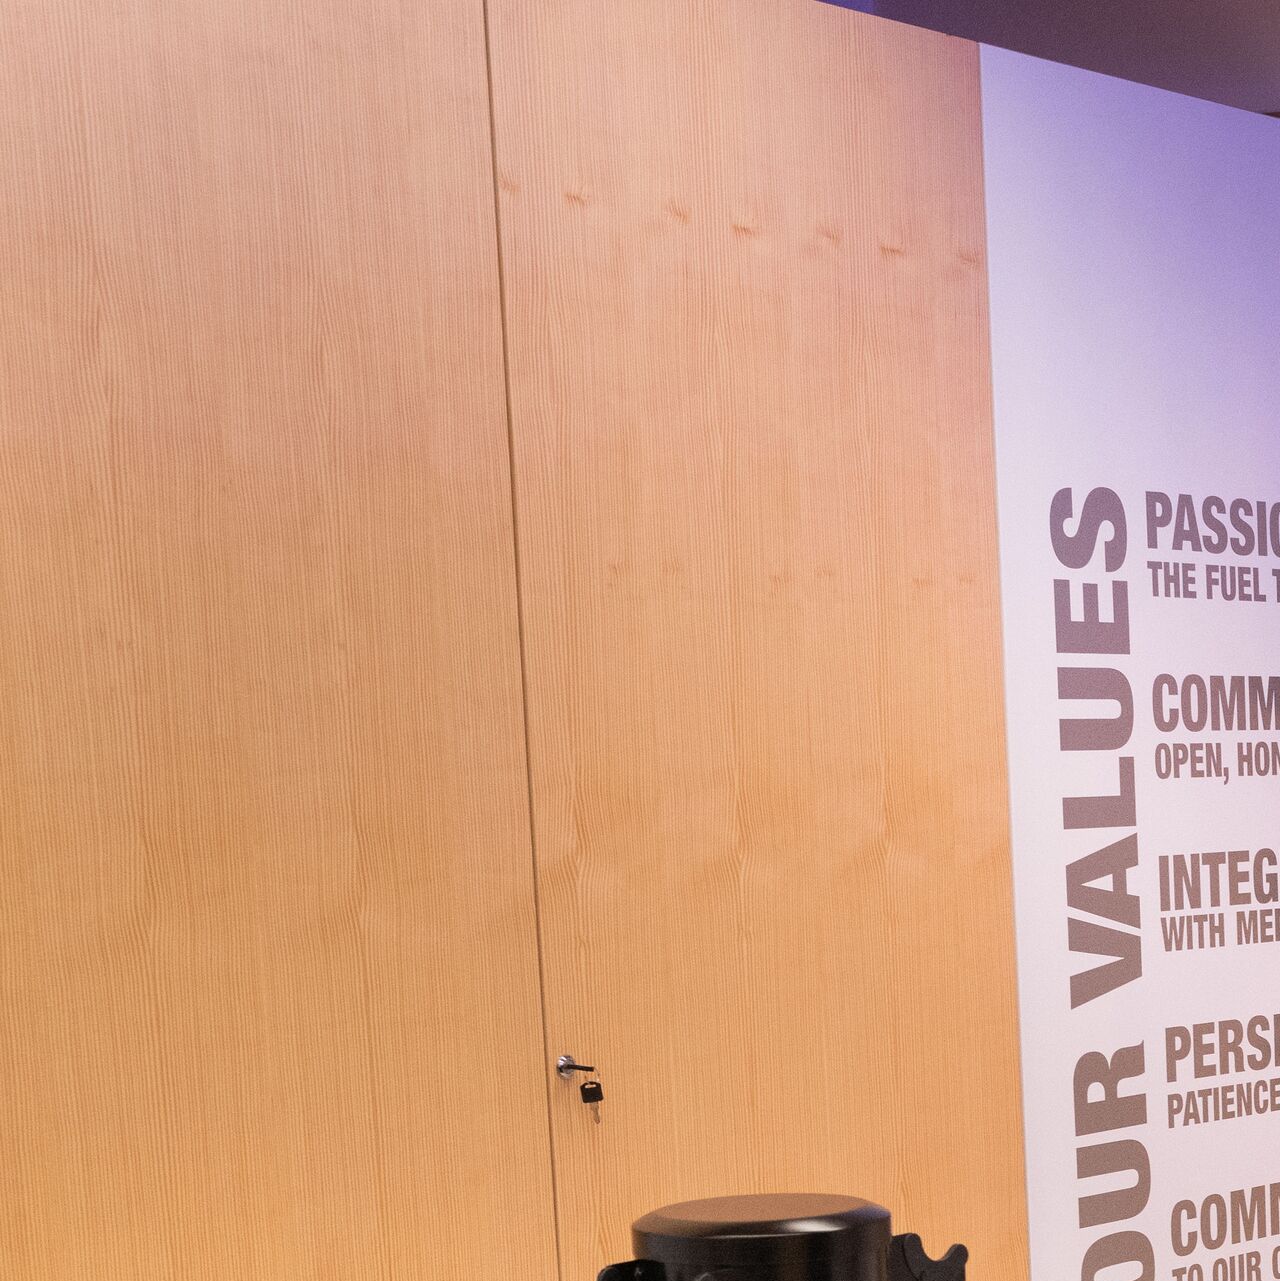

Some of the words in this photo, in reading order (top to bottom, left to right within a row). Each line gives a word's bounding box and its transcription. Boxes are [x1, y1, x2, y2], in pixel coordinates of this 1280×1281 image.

[1147, 561, 1196, 599] THE
[1206, 565, 1267, 602] FUEL
[1049, 486, 1142, 1010] VALUES
[1154, 742, 1229, 784] OPEN,
[1160, 913, 1225, 952] WITH
